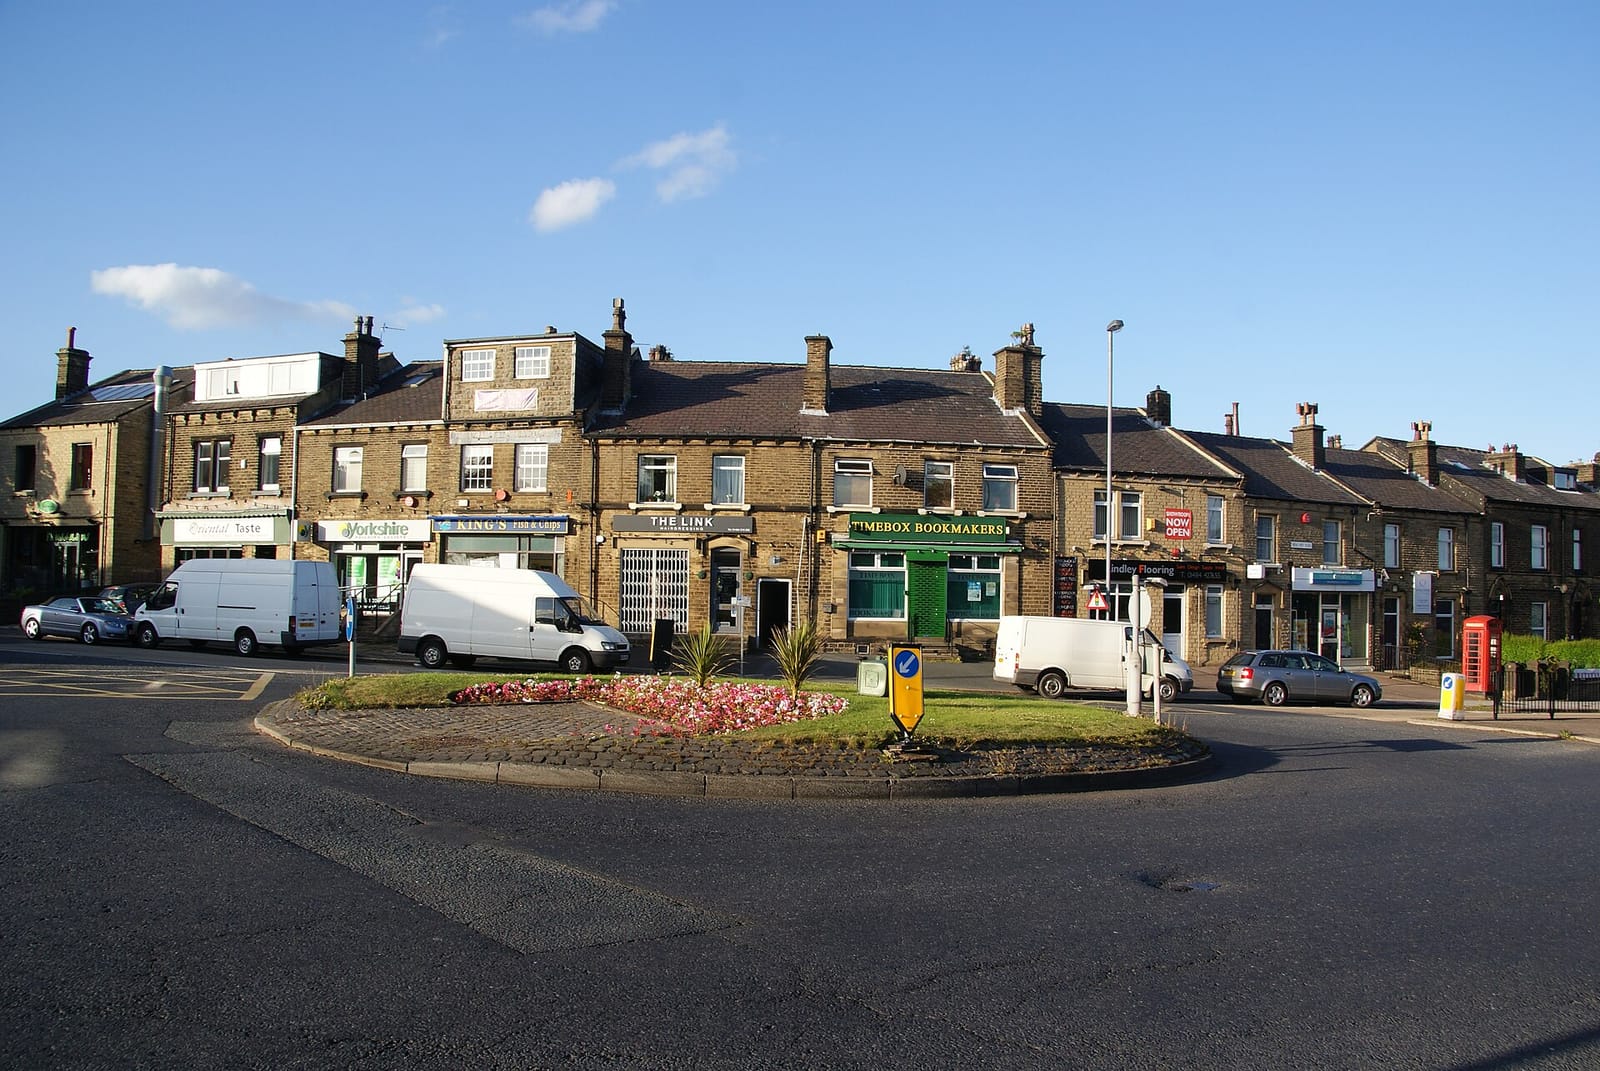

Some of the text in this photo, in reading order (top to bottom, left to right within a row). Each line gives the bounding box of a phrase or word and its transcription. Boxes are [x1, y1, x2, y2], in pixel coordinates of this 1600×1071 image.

[456, 519, 561, 530] KING'S Fish & Chips
[650, 516, 713, 527] THE LINK
[1166, 518, 1190, 527] NOW
[235, 523, 261, 533] Taste
[347, 521, 408, 539] Yorkshire
[851, 521, 1004, 535] TIMEBOX BOOKMAKERS
[1166, 527, 1190, 536] OPEN
[1110, 564, 1137, 575] indley
[1138, 564, 1174, 576] Flooring
